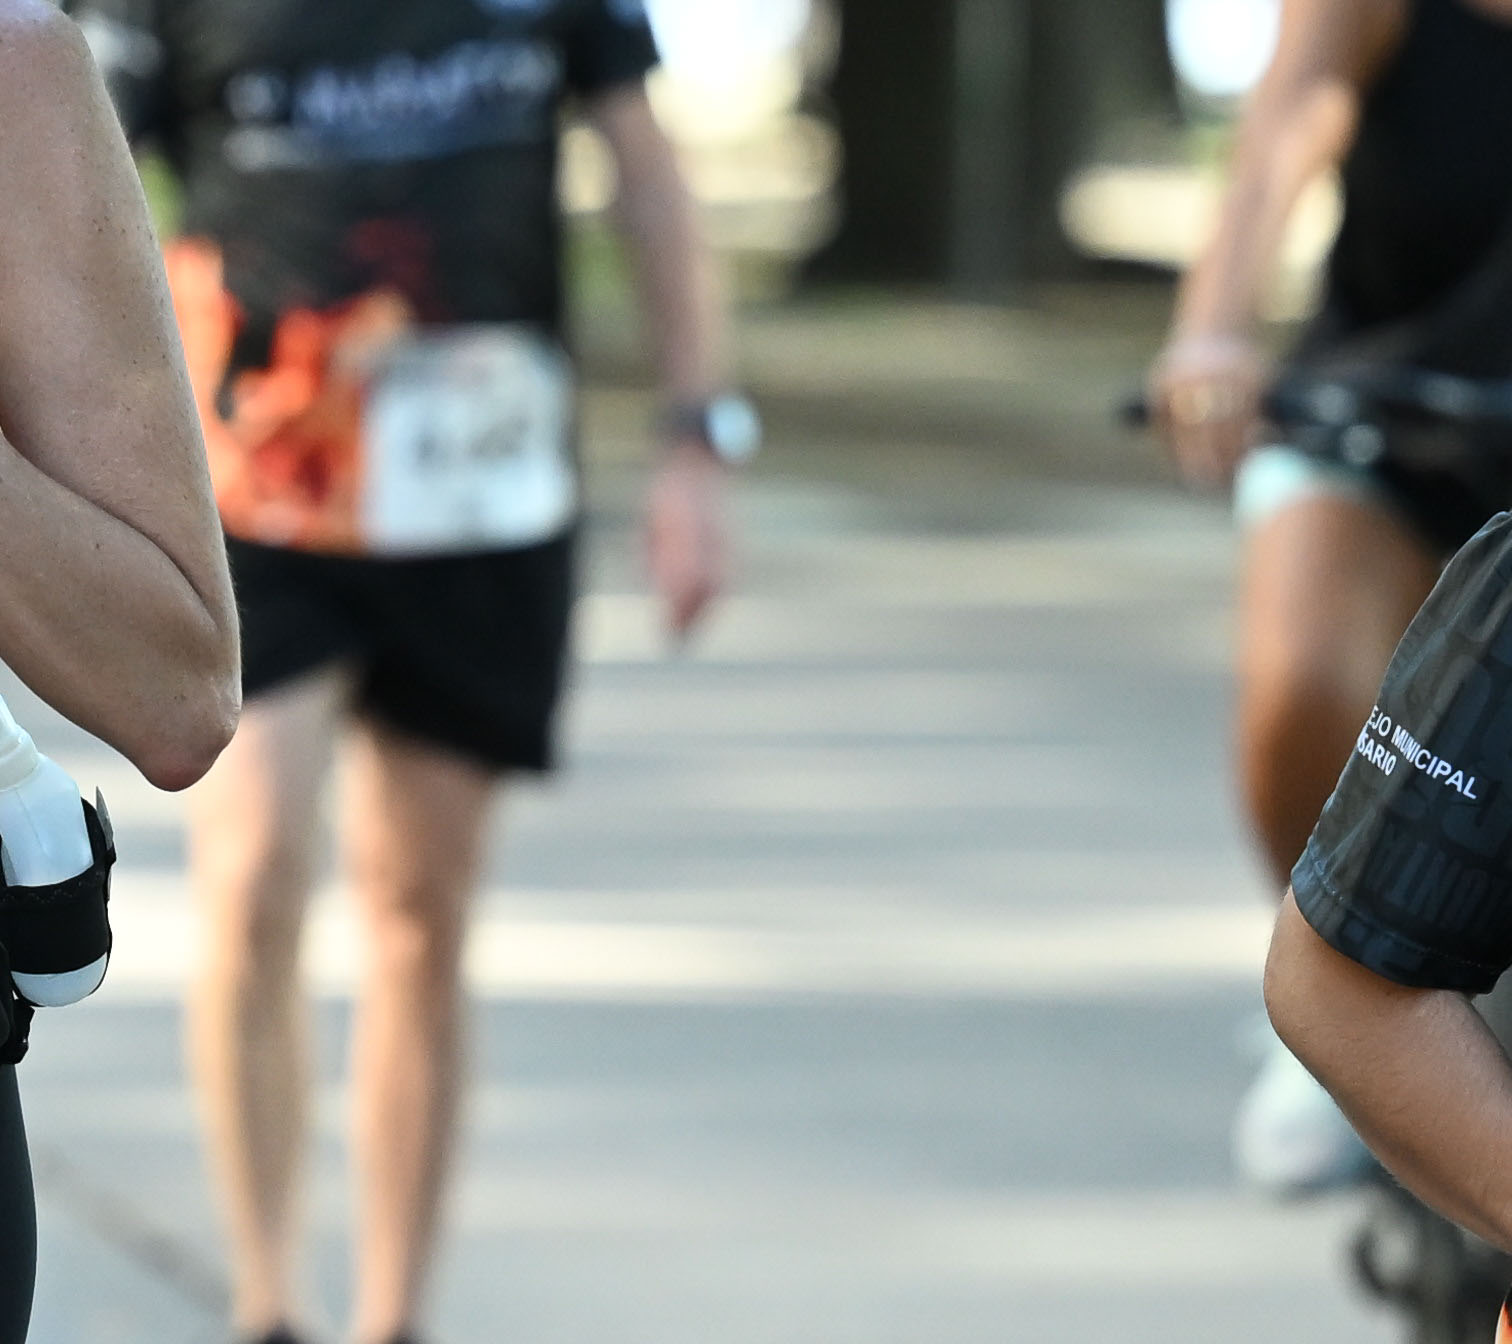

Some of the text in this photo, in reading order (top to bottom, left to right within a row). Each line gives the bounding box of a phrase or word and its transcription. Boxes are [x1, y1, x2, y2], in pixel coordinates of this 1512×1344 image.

[1357, 731, 1397, 776] SARIO
[1367, 703, 1478, 800] EJO MUNICIPAL
